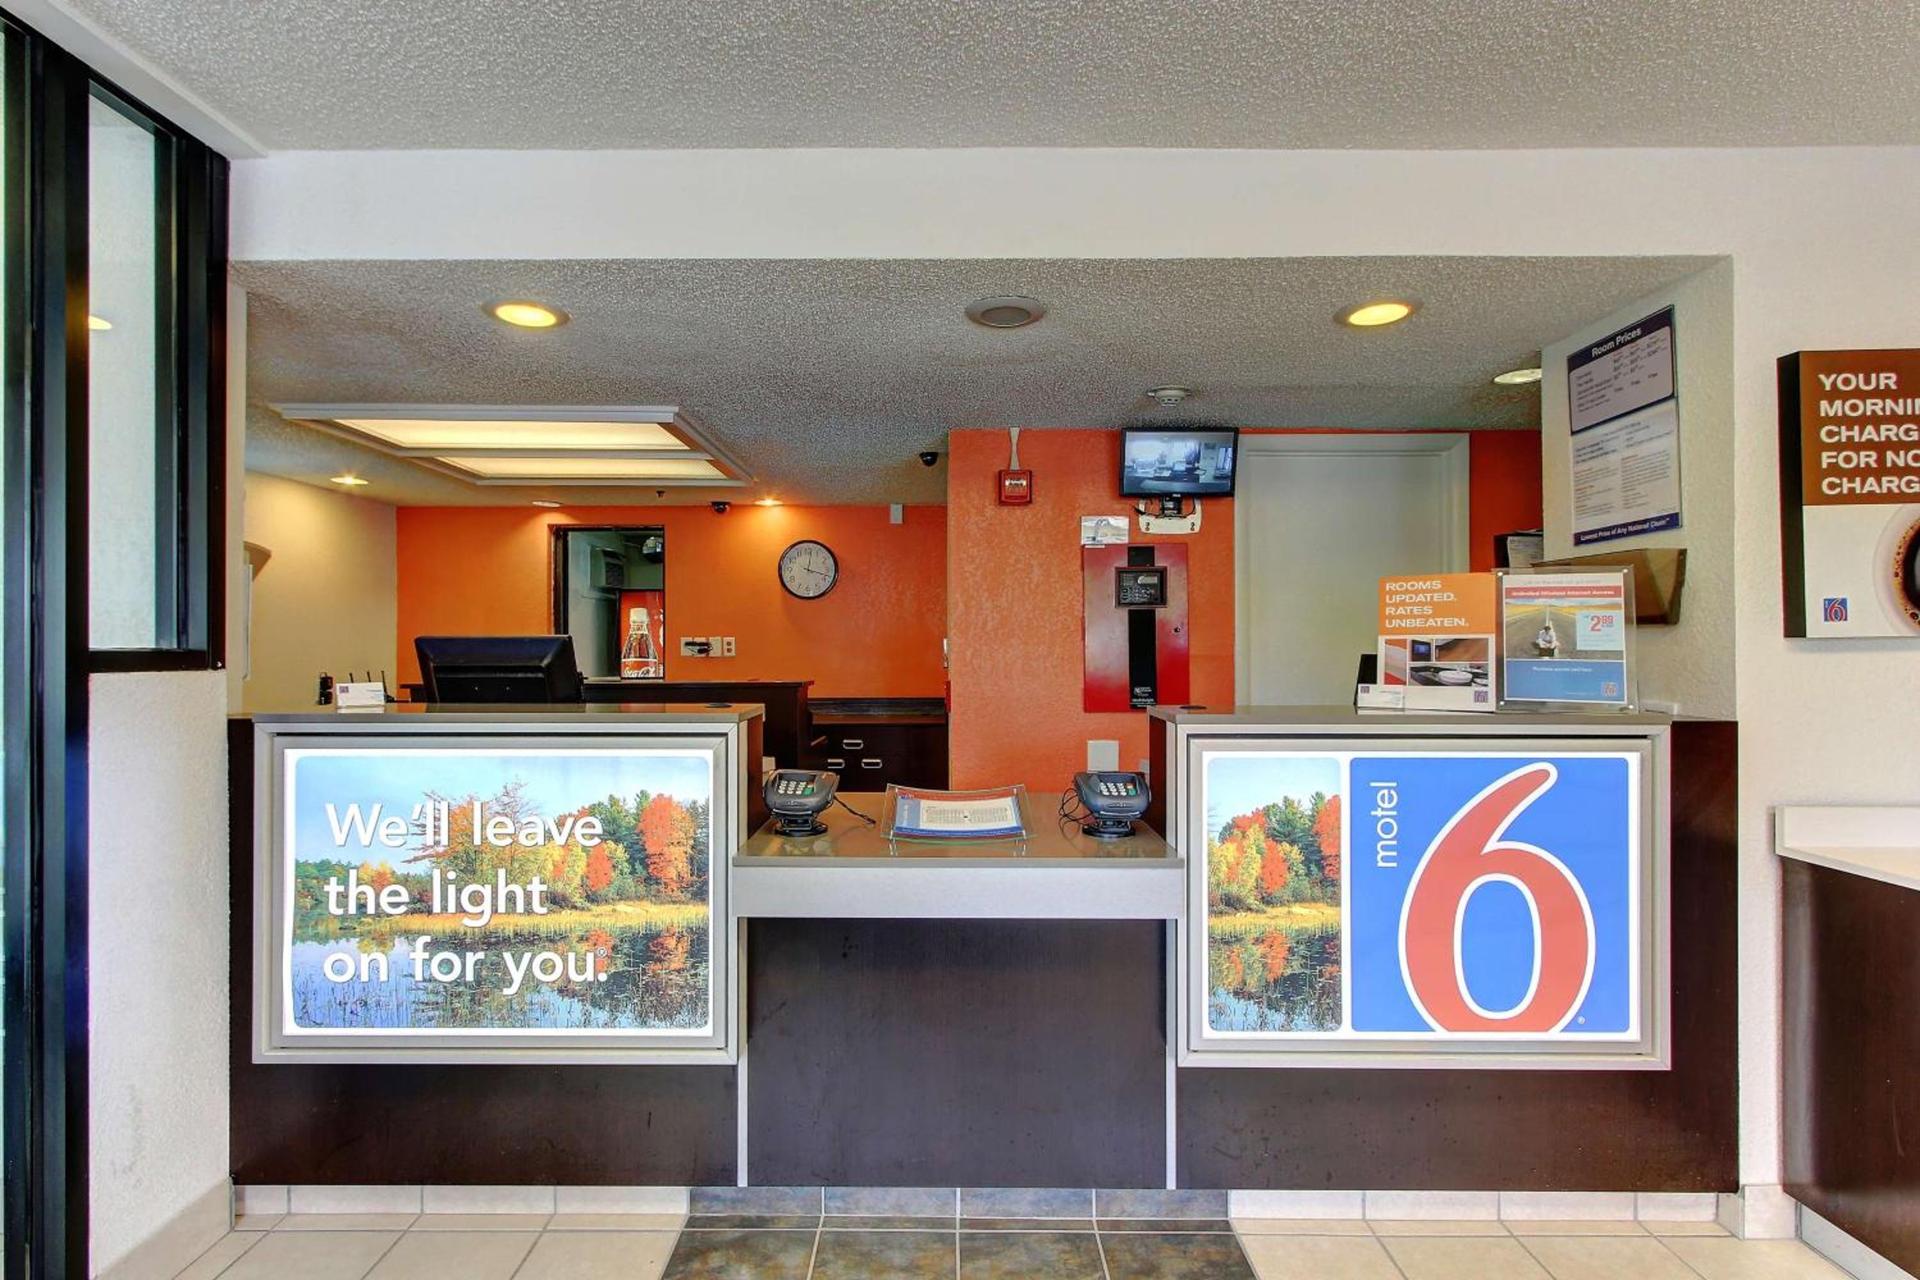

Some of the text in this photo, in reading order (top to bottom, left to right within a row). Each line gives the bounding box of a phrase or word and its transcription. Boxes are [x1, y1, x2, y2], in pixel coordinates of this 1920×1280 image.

[1591, 327, 1642, 358] Room Prices
[1818, 372, 1898, 391] YOUR
[1820, 398, 1920, 417] MORNI
[1821, 451, 1879, 469] FOR
[1385, 580, 1442, 592] ROOMS
[1385, 592, 1457, 604] UPDATED.
[1385, 605, 1434, 616] RATES
[1385, 617, 1470, 628] UNBEATEN.
[324, 799, 604, 849] We'll leave
[1369, 781, 1399, 869] motel
[323, 867, 549, 928] the light
[1398, 761, 1597, 1034] 6
[323, 951, 390, 984] on
[409, 935, 486, 984] for
